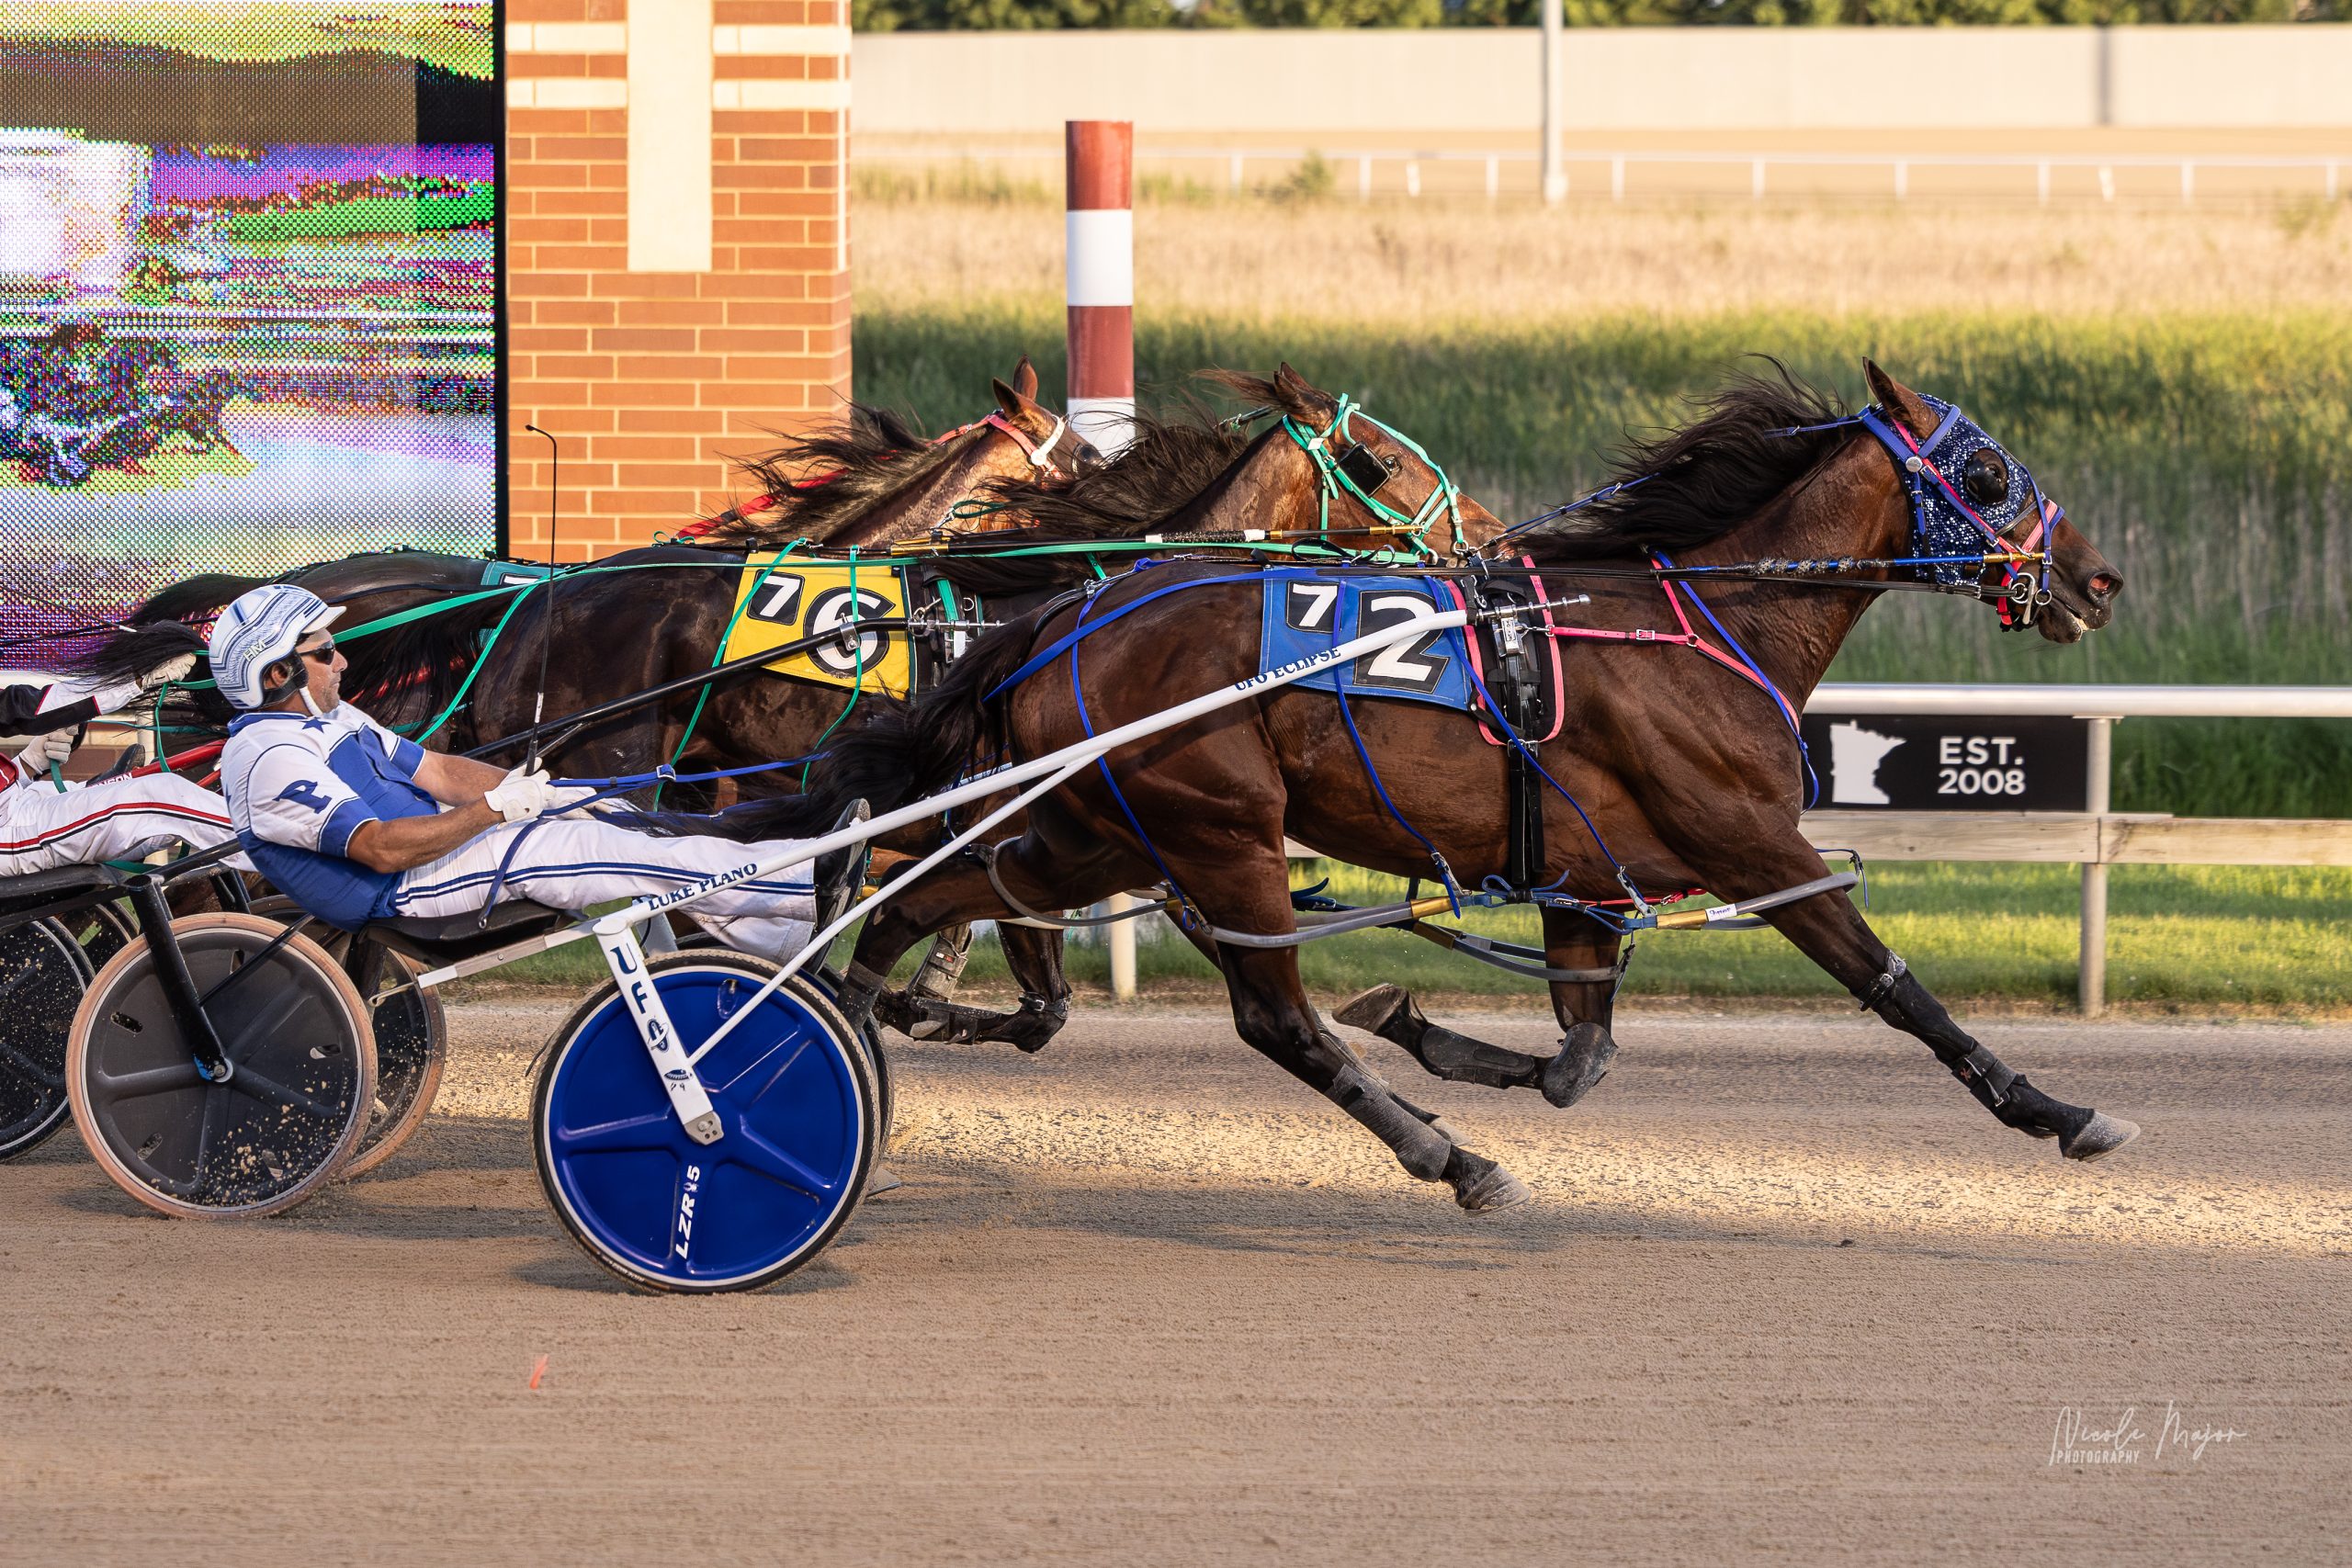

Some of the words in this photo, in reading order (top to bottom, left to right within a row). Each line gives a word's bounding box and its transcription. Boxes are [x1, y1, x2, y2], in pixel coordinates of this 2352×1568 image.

[759, 575, 801, 617] 7
[810, 591, 882, 671] 6
[1292, 583, 1338, 627] 7
[1367, 595, 1436, 682] 2
[1235, 673, 1268, 691] UFO
[1272, 647, 1341, 679] ECLIPSE
[1939, 737, 2024, 765] EST.
[272, 779, 333, 815] P
[1938, 768, 2026, 795] 2008
[649, 884, 695, 910] LUKE
[698, 863, 758, 894] PLANO
